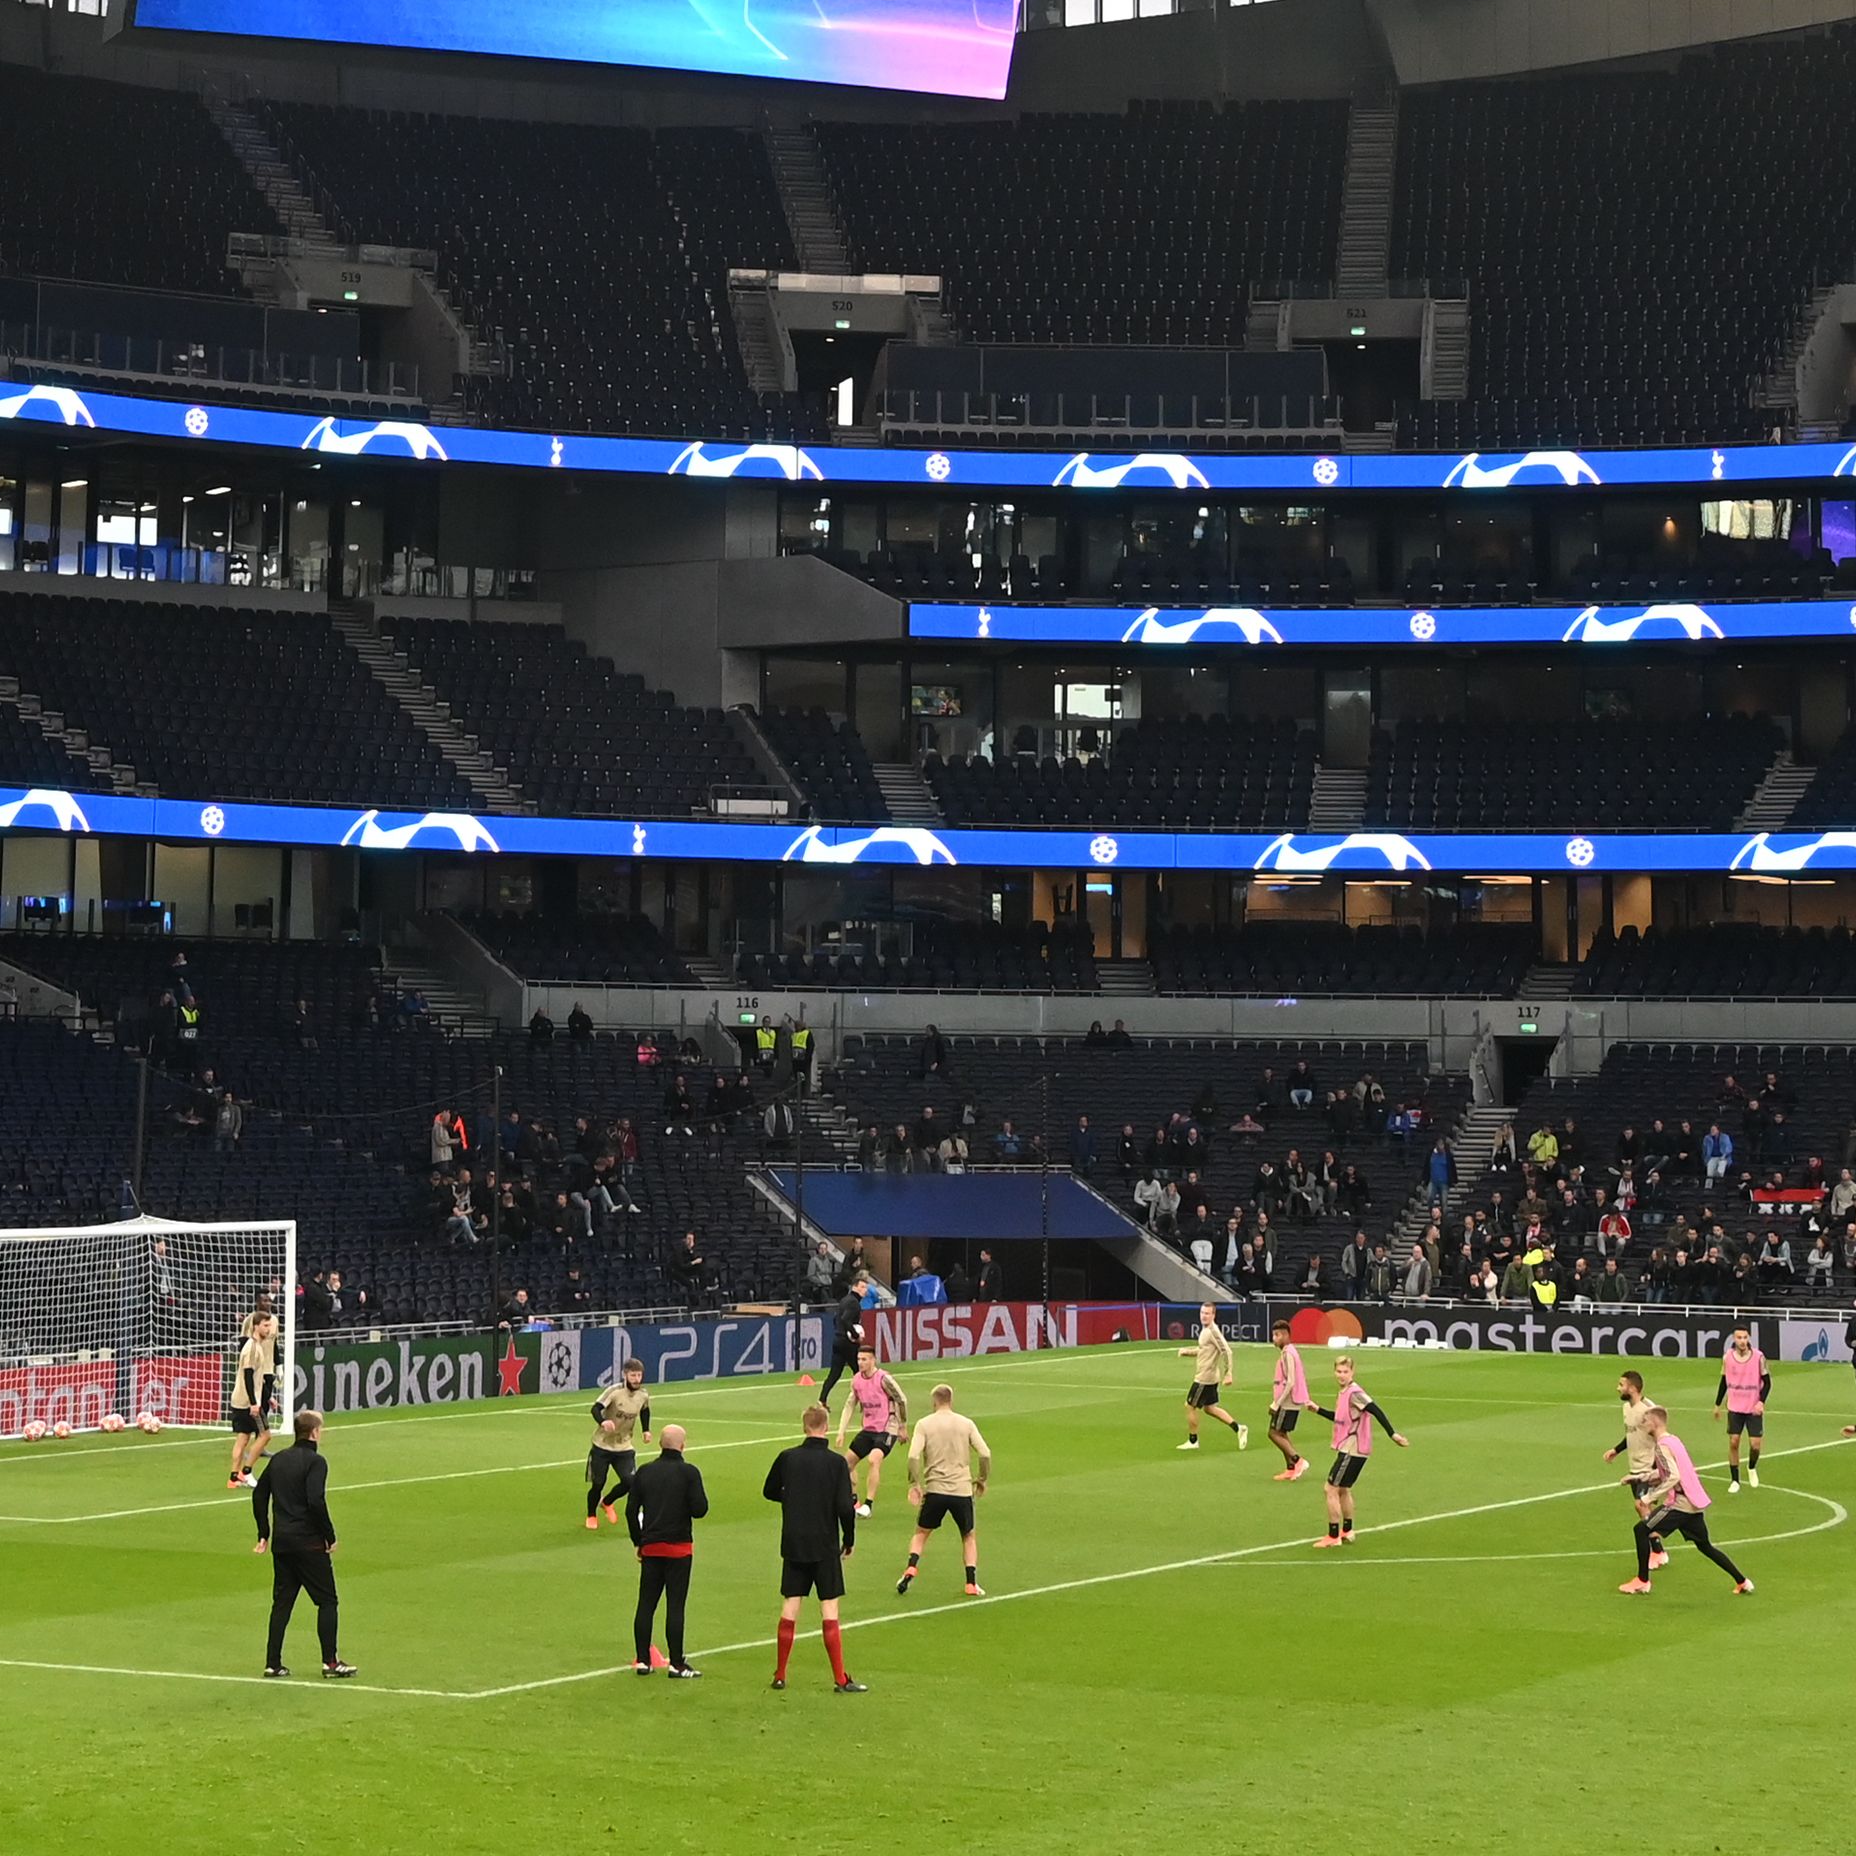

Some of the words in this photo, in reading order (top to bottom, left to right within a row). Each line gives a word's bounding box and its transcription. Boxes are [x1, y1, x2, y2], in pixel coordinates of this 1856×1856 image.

[341, 272, 362, 284] 519
[832, 300, 853, 312] 520
[736, 997, 759, 1010] 116
[1517, 1006, 1541, 1020] 117
[875, 1304, 1078, 1363] NISSAN
[1190, 1324, 1261, 1339] RPECT
[1384, 1314, 1759, 1358] mastercard
[294, 1341, 486, 1416] eineken
